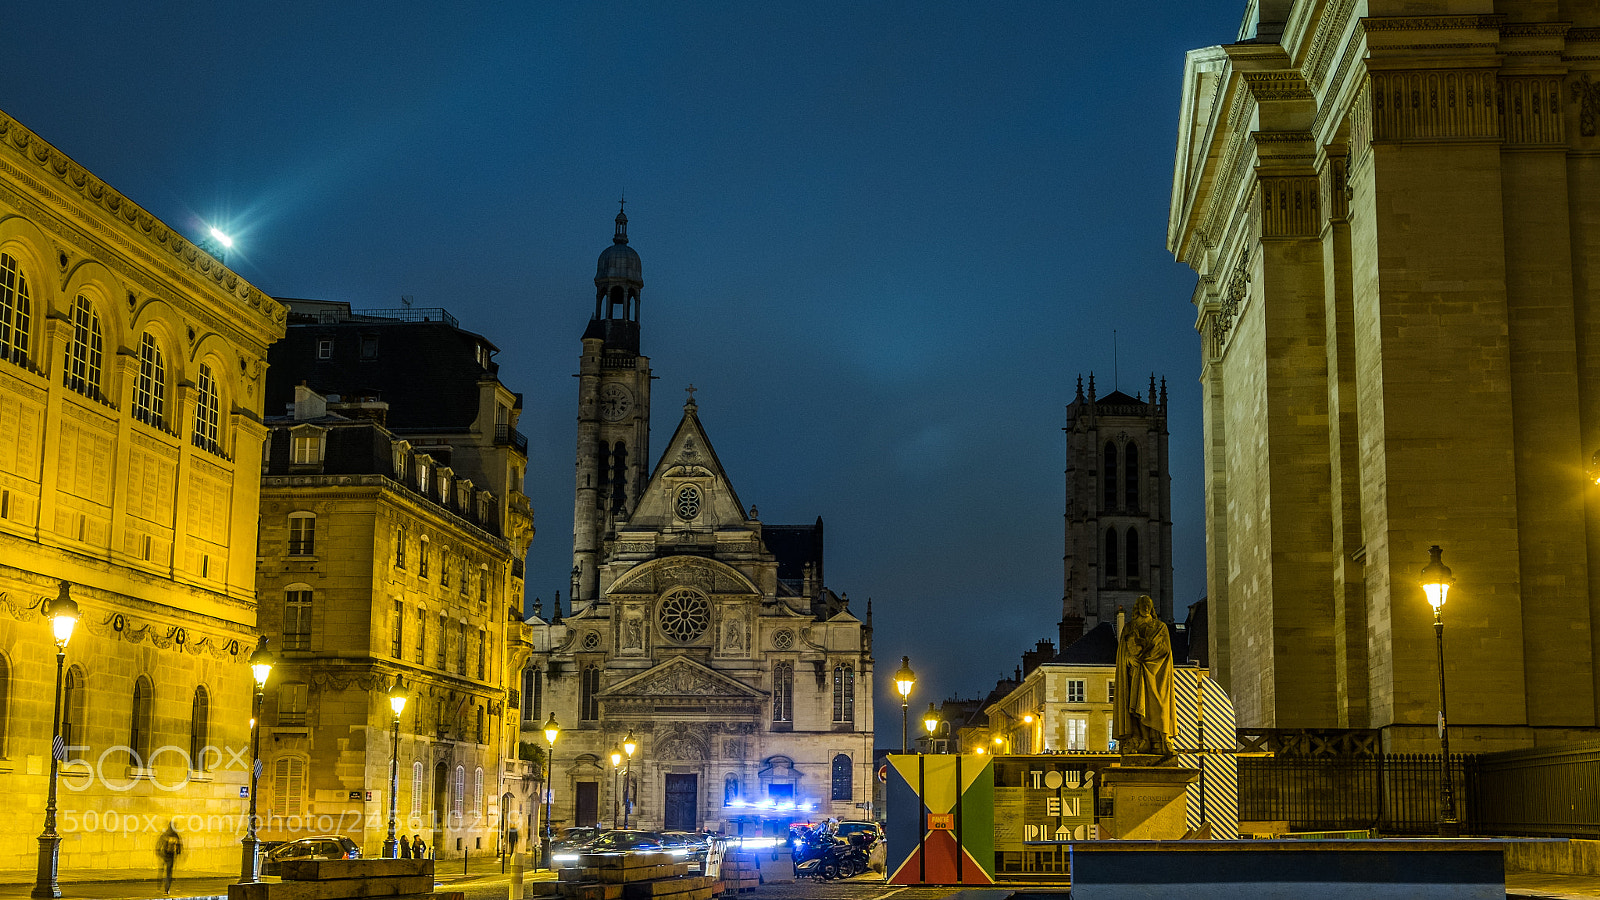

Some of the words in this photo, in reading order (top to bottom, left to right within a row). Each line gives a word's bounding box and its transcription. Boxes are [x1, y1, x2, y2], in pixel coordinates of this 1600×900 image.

[1030, 770, 1095, 790] TOUS
[1046, 797, 1080, 817] EN
[1024, 824, 1099, 841] PLACE
